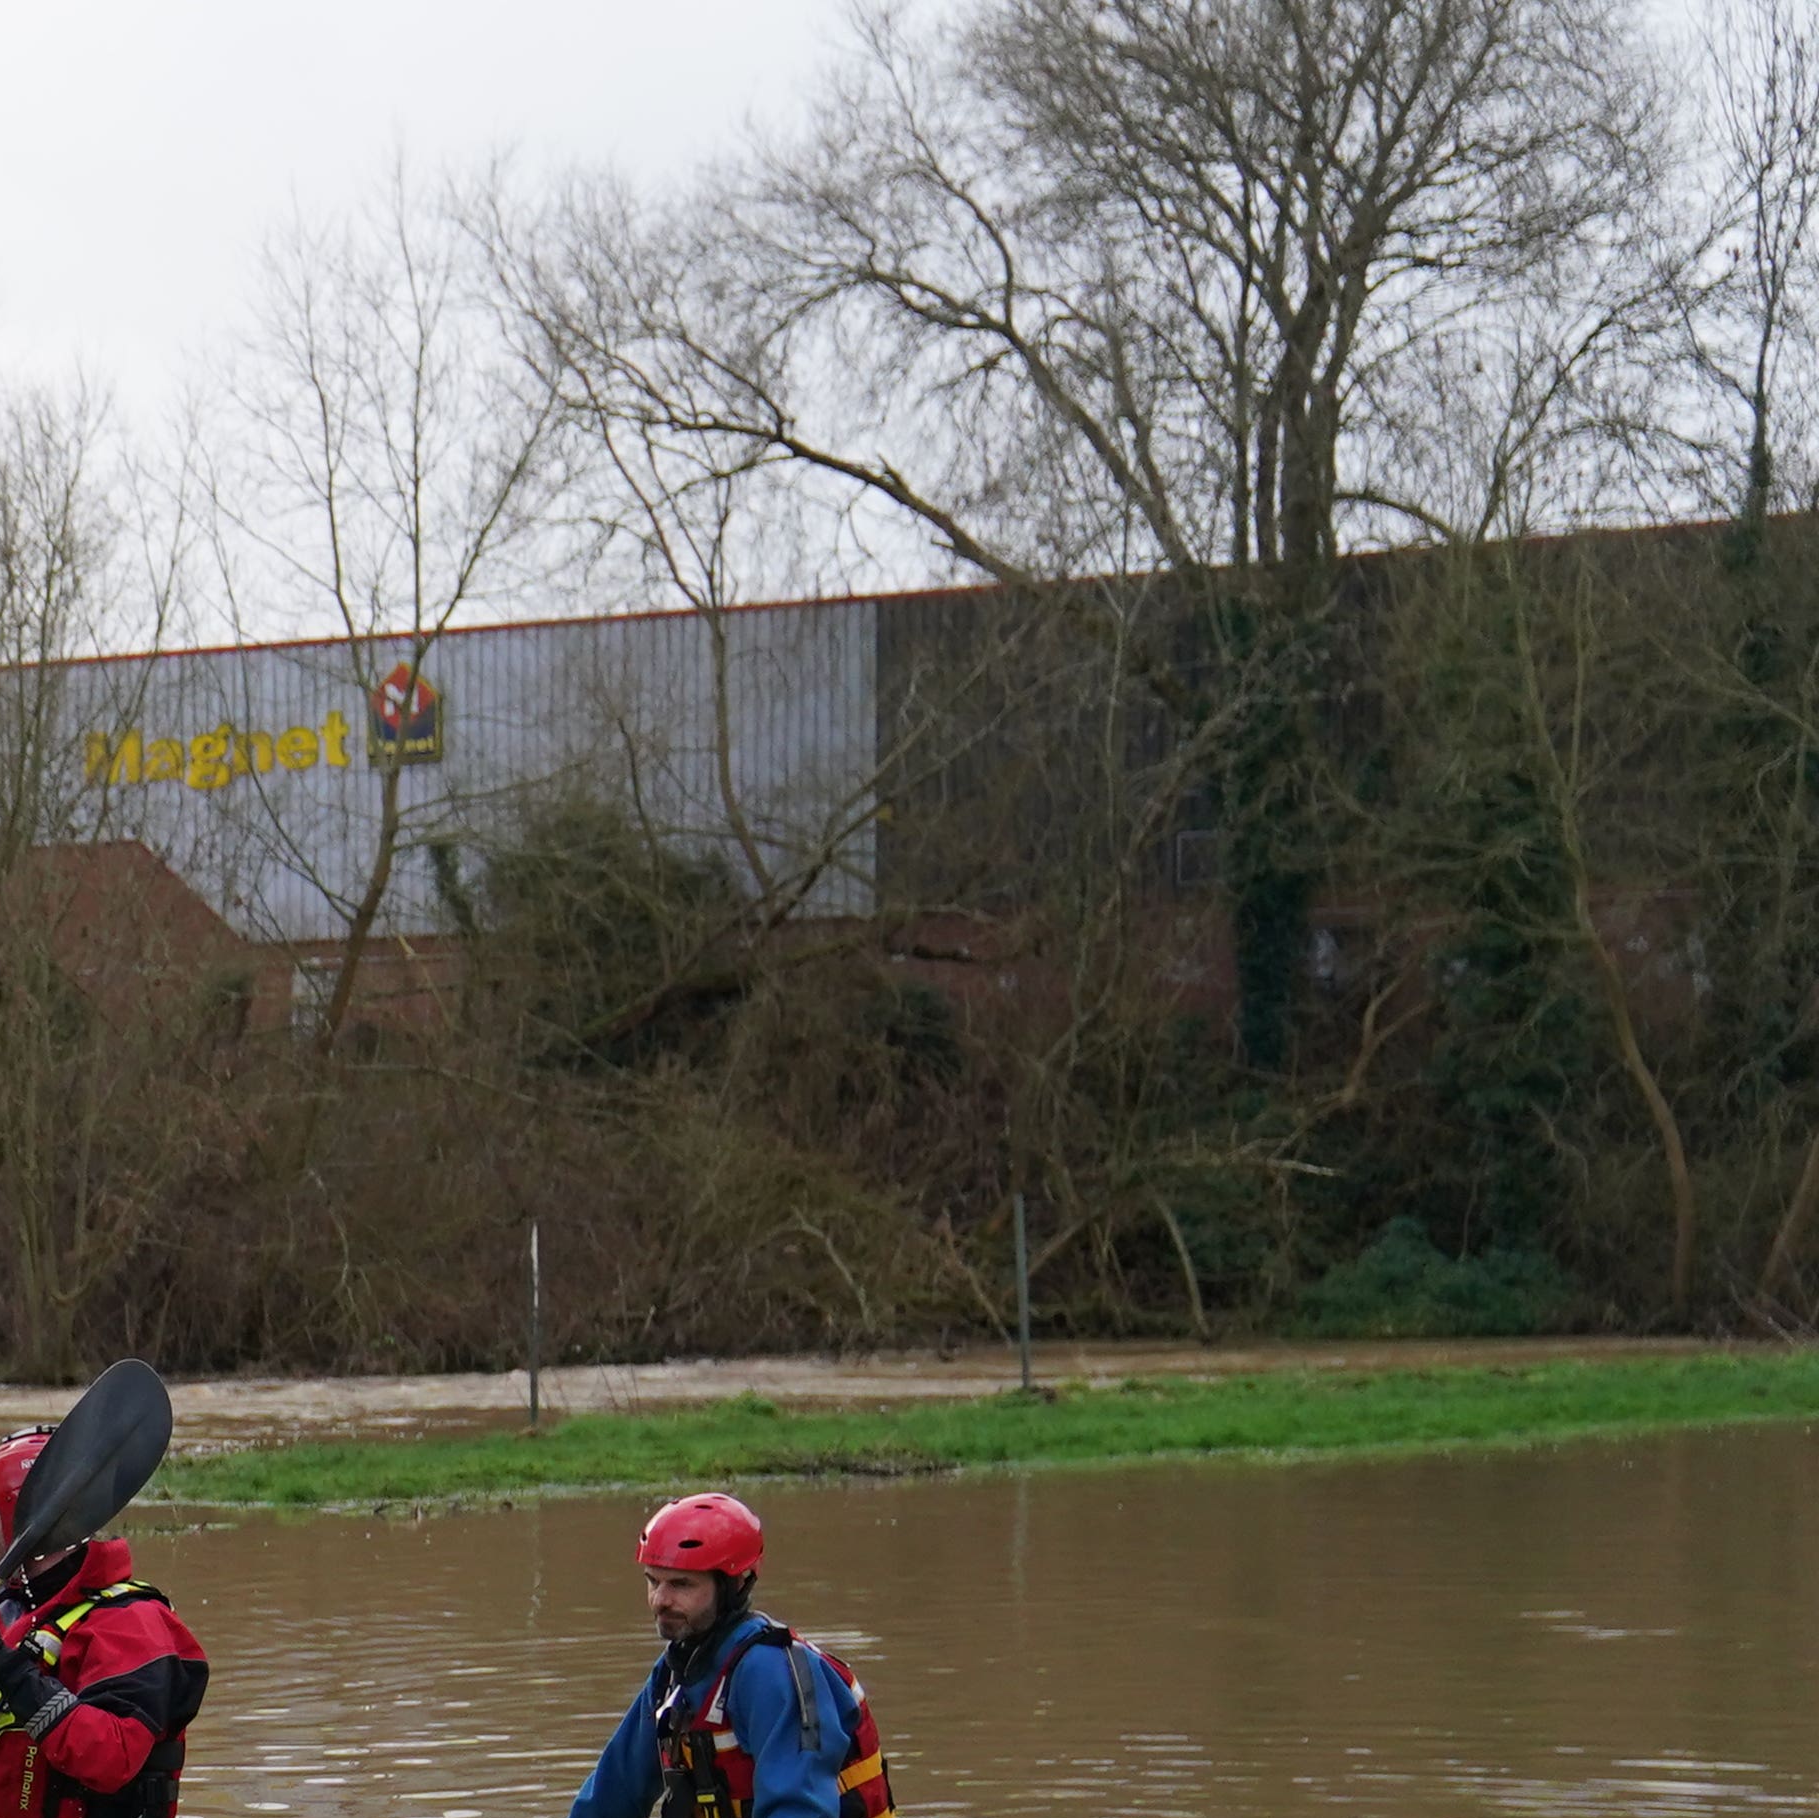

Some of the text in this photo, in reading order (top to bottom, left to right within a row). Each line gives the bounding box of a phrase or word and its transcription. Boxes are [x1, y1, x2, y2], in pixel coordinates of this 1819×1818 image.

[85, 710, 350, 789] Magnet
[20, 1746, 38, 1810] Pro Matrix
